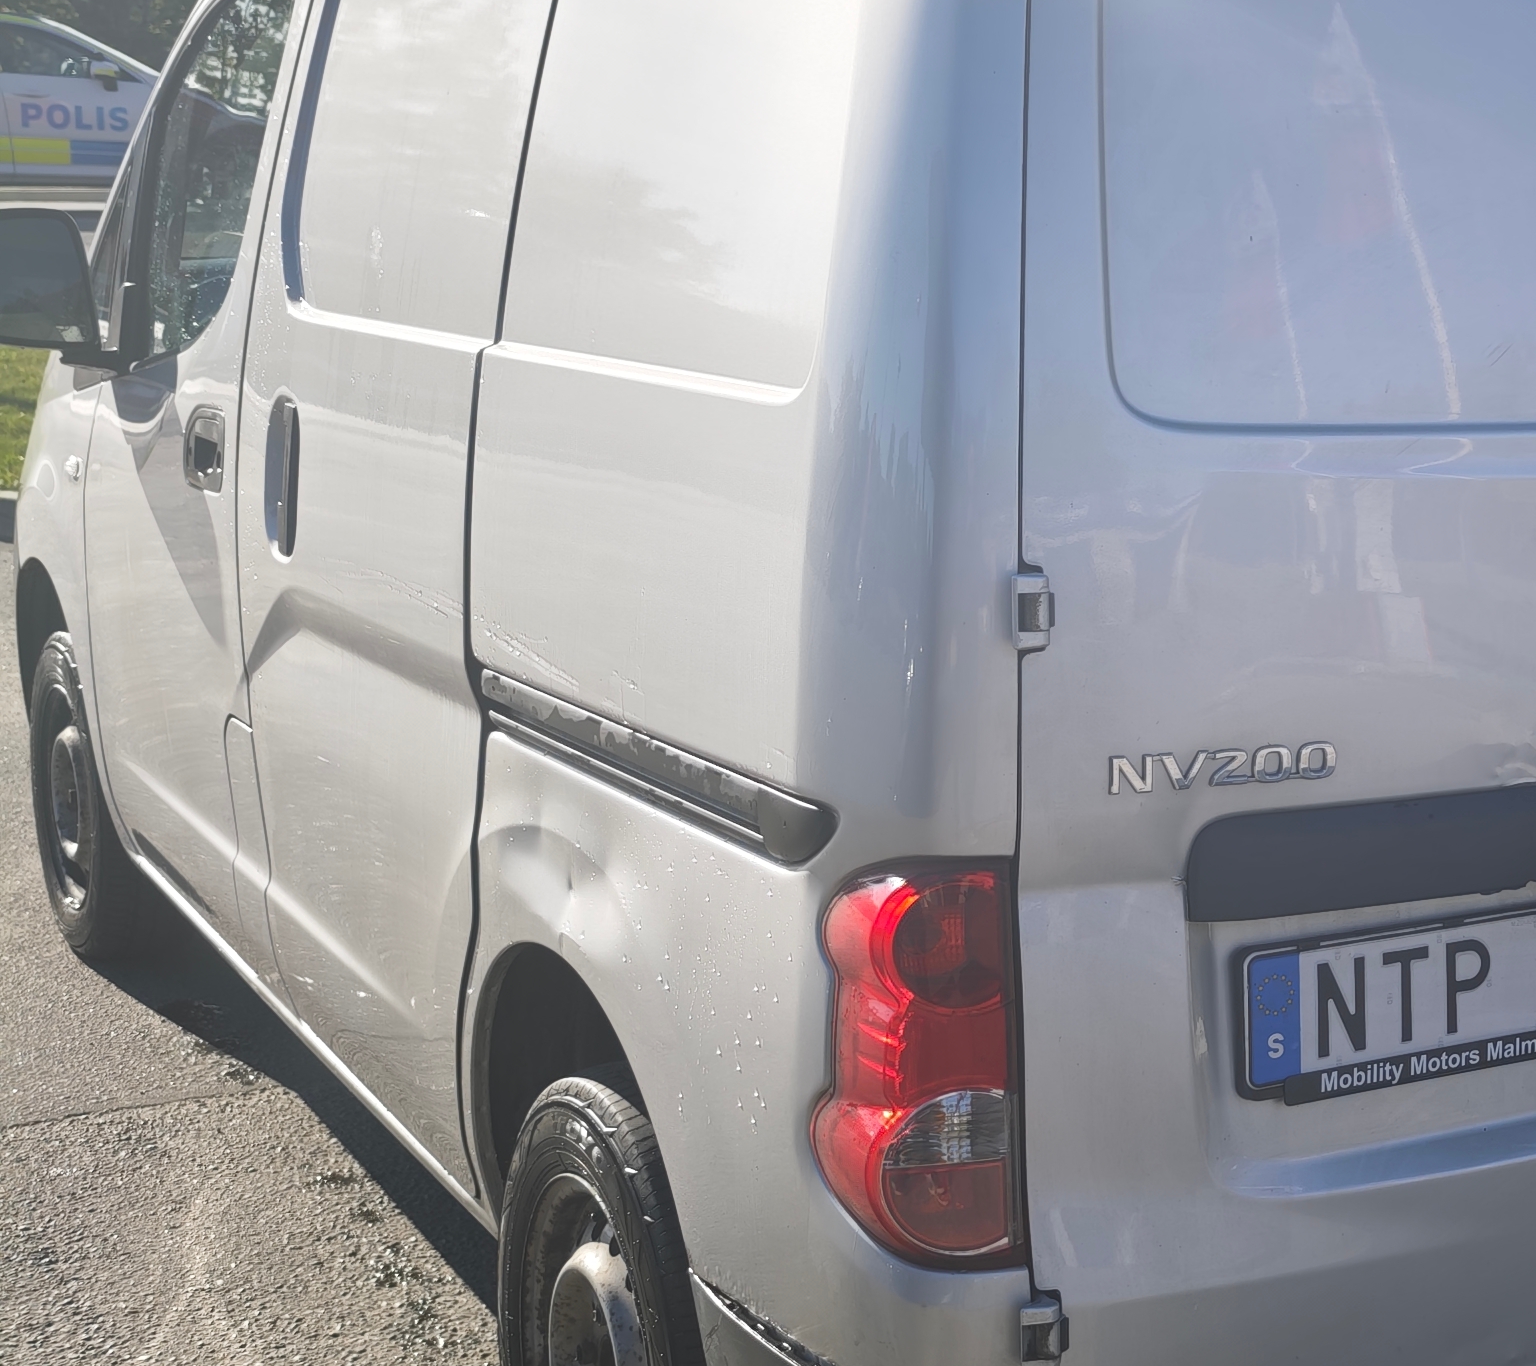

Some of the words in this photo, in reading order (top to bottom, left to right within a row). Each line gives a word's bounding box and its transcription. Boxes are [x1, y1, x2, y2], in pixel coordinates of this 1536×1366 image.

[19, 102, 130, 132] POLIS
[1108, 741, 1337, 794] NV200
[1314, 938, 1492, 1059] NTP
[1267, 1032, 1285, 1060] S
[1320, 1061, 1404, 1094] Mobility
[1410, 1047, 1480, 1077] Motors
